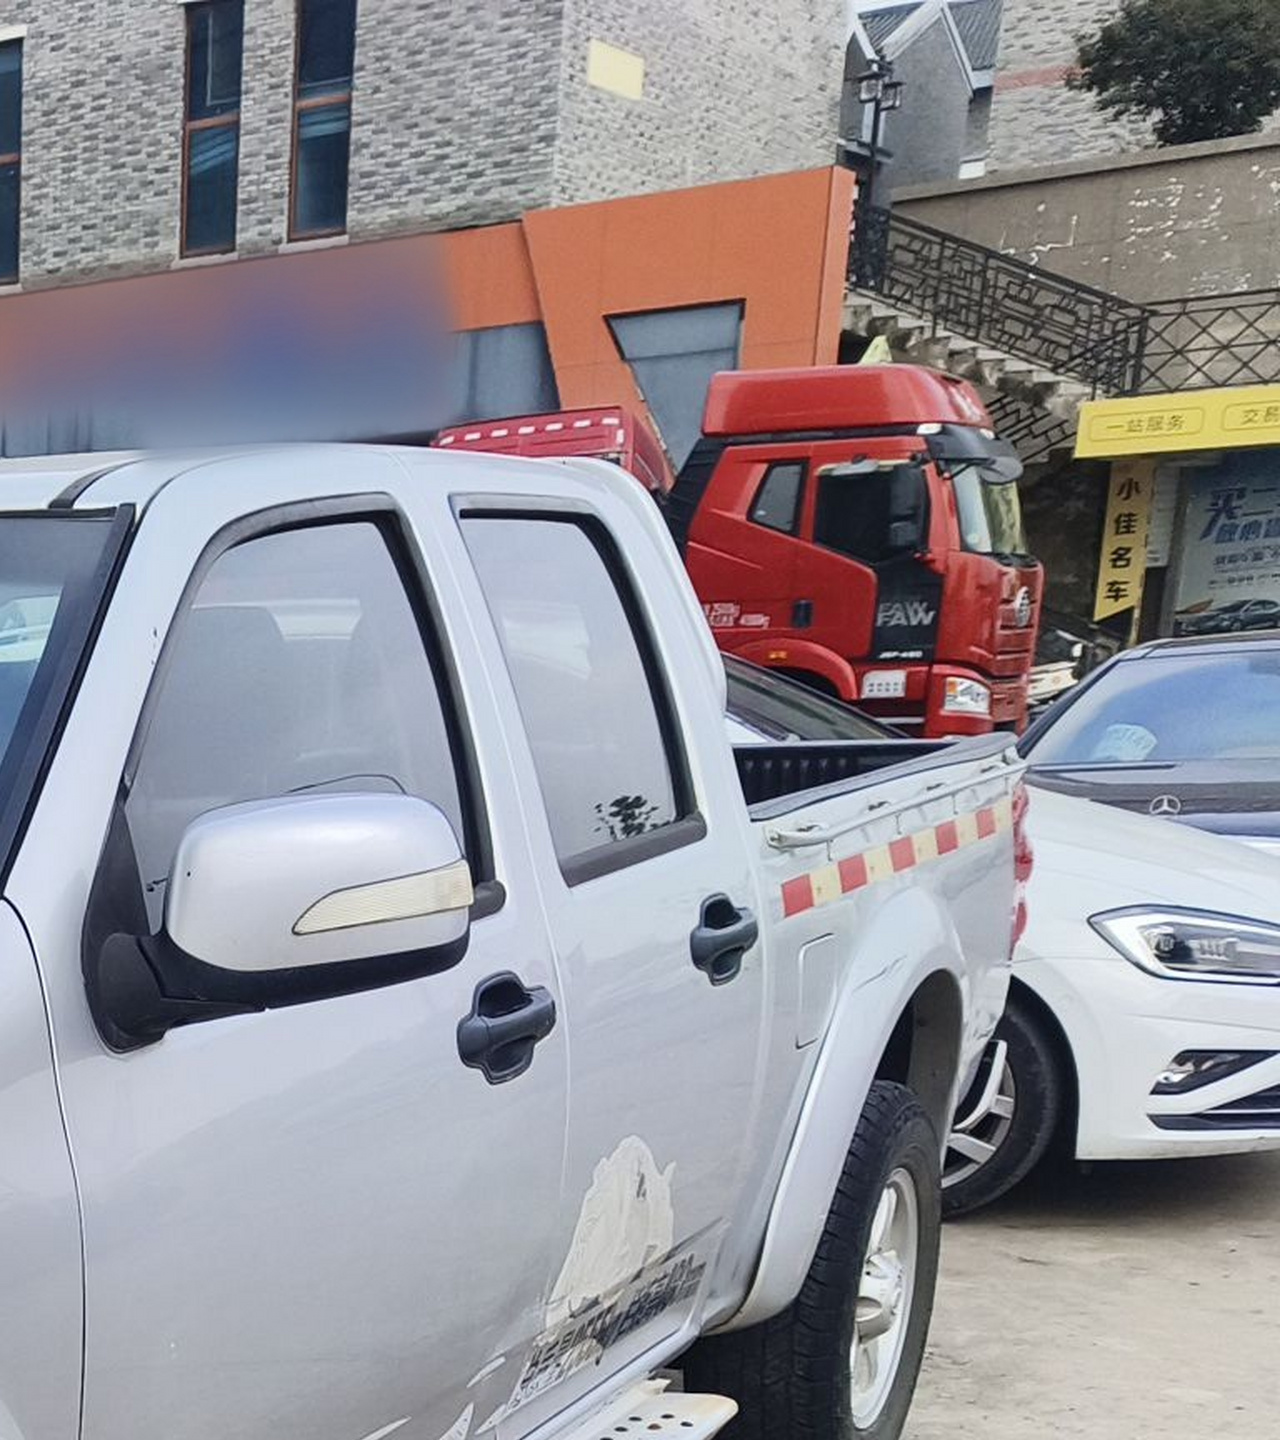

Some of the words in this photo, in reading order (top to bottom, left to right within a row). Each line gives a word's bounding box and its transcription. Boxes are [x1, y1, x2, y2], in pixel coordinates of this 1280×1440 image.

[1106, 413, 1185, 434] 一站服务
[1103, 477, 1141, 603] 小佳名车
[875, 602, 937, 627] FAW
